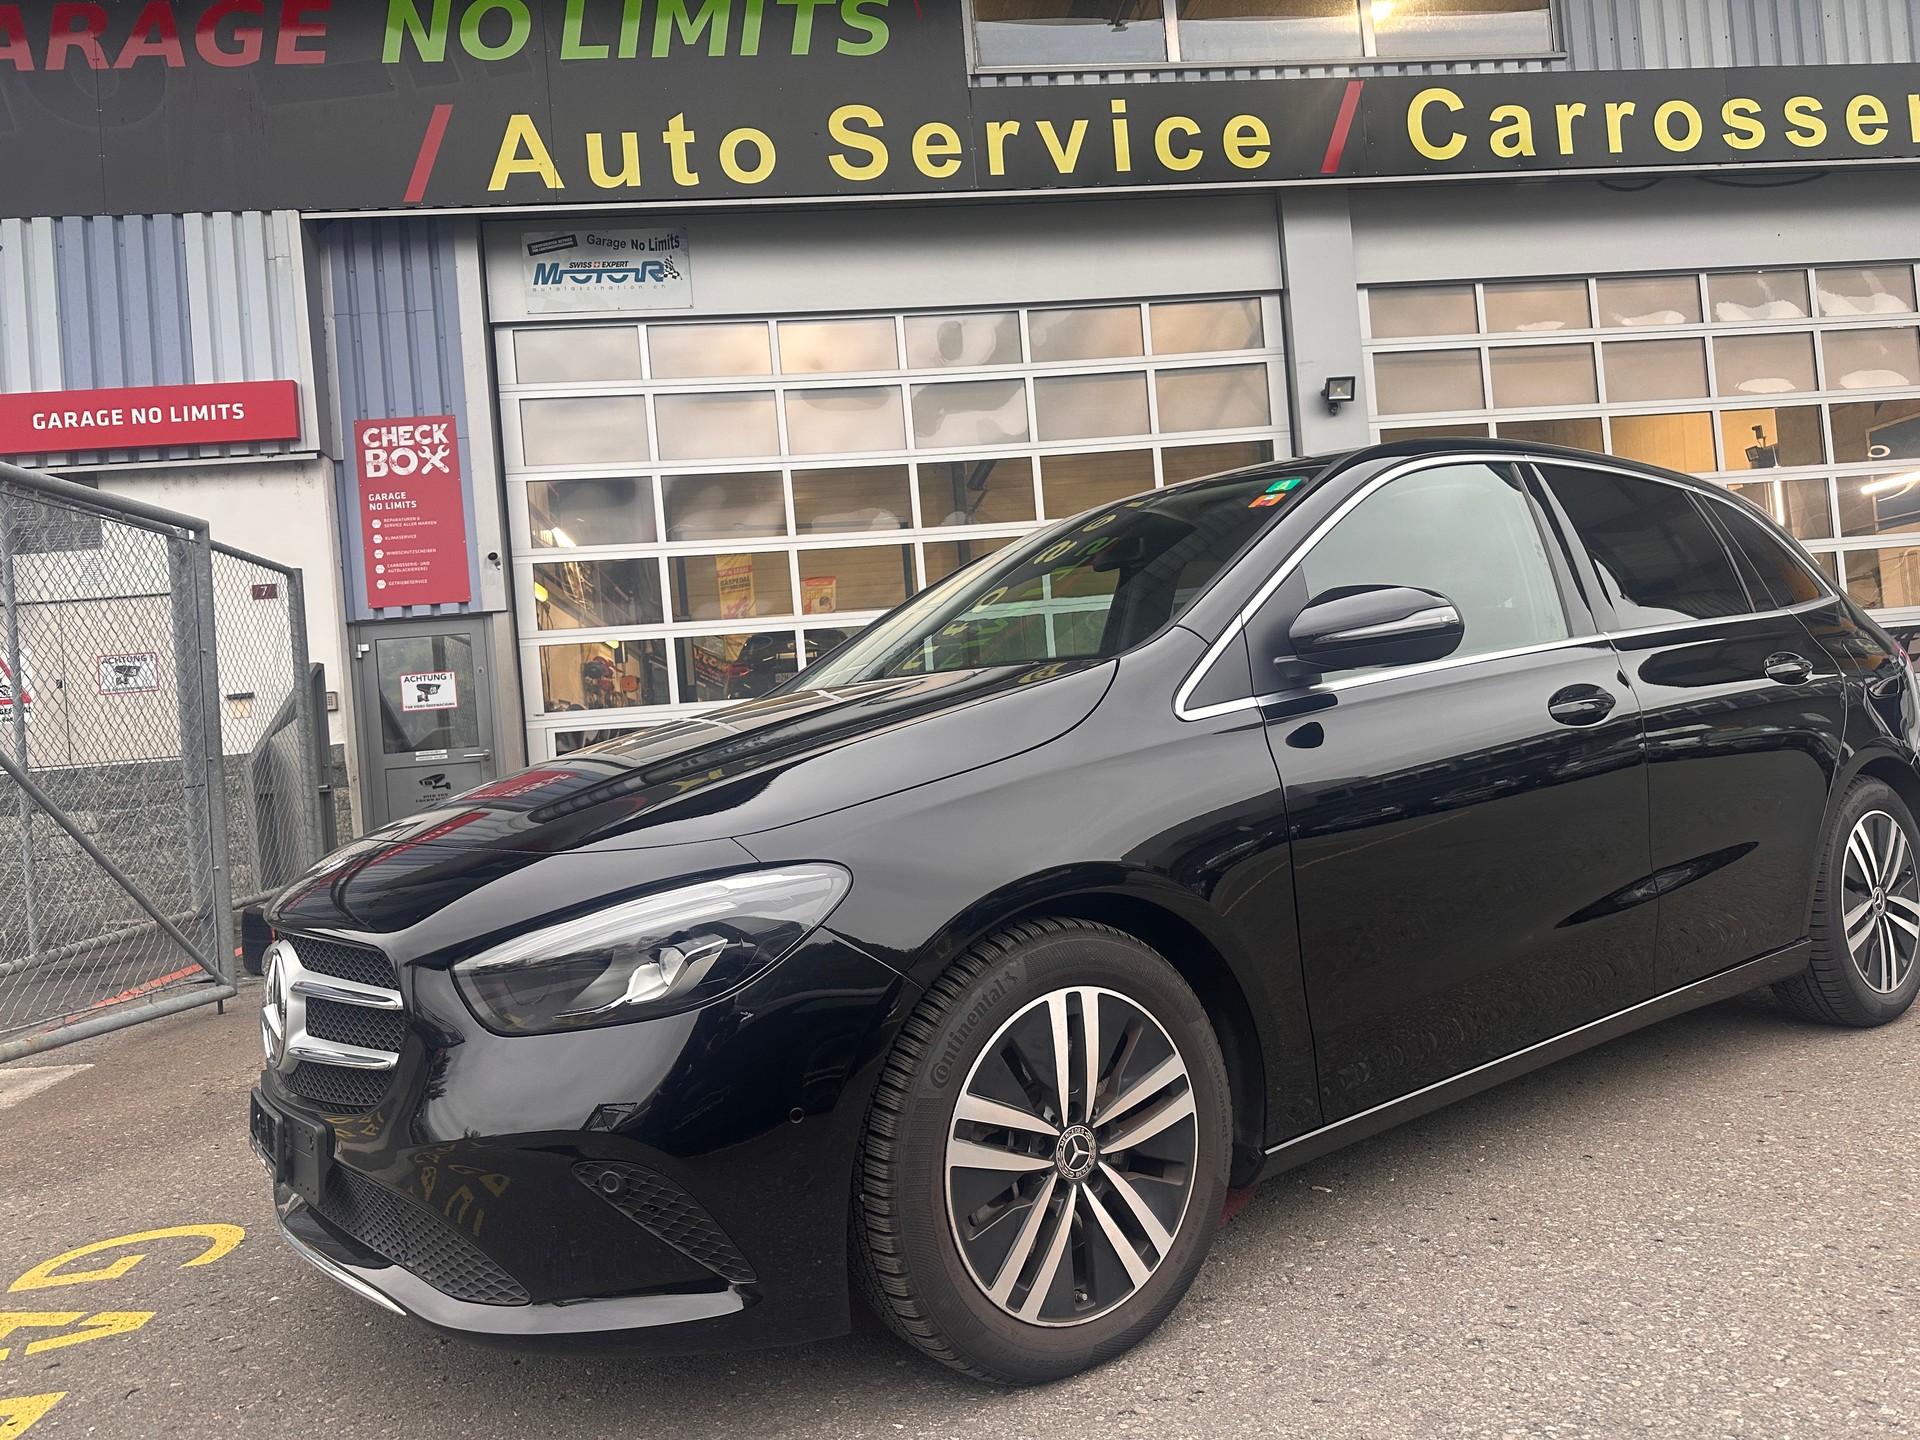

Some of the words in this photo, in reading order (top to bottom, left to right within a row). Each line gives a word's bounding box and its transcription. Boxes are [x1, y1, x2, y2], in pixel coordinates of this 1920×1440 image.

[381, 0, 532, 63] NO
[560, 0, 891, 60] LIMITS
[487, 112, 777, 192] Auto
[827, 98, 1272, 182] Service
[586, 234, 627, 250] Garage
[631, 238, 645, 252] No
[648, 233, 680, 252] Limits
[569, 261, 592, 269] SWISS
[601, 260, 629, 268] EXPERT
[32, 408, 124, 430] GARAGE
[131, 406, 163, 425] NO
[170, 402, 245, 423] LIMITS
[362, 423, 450, 448] CHECK
[368, 491, 407, 502] GARAGE
[369, 502, 383, 511] NO
[385, 500, 417, 511] LIMITS
[260, 585, 268, 597] 7
[101, 654, 148, 665] ACHTUNG
[404, 673, 447, 683] ACHTUNG
[930, 978, 1006, 1089] Continental
[1202, 1033, 1230, 1141] WinterContact
[1059, 1127, 1085, 1147] MERCEDES
